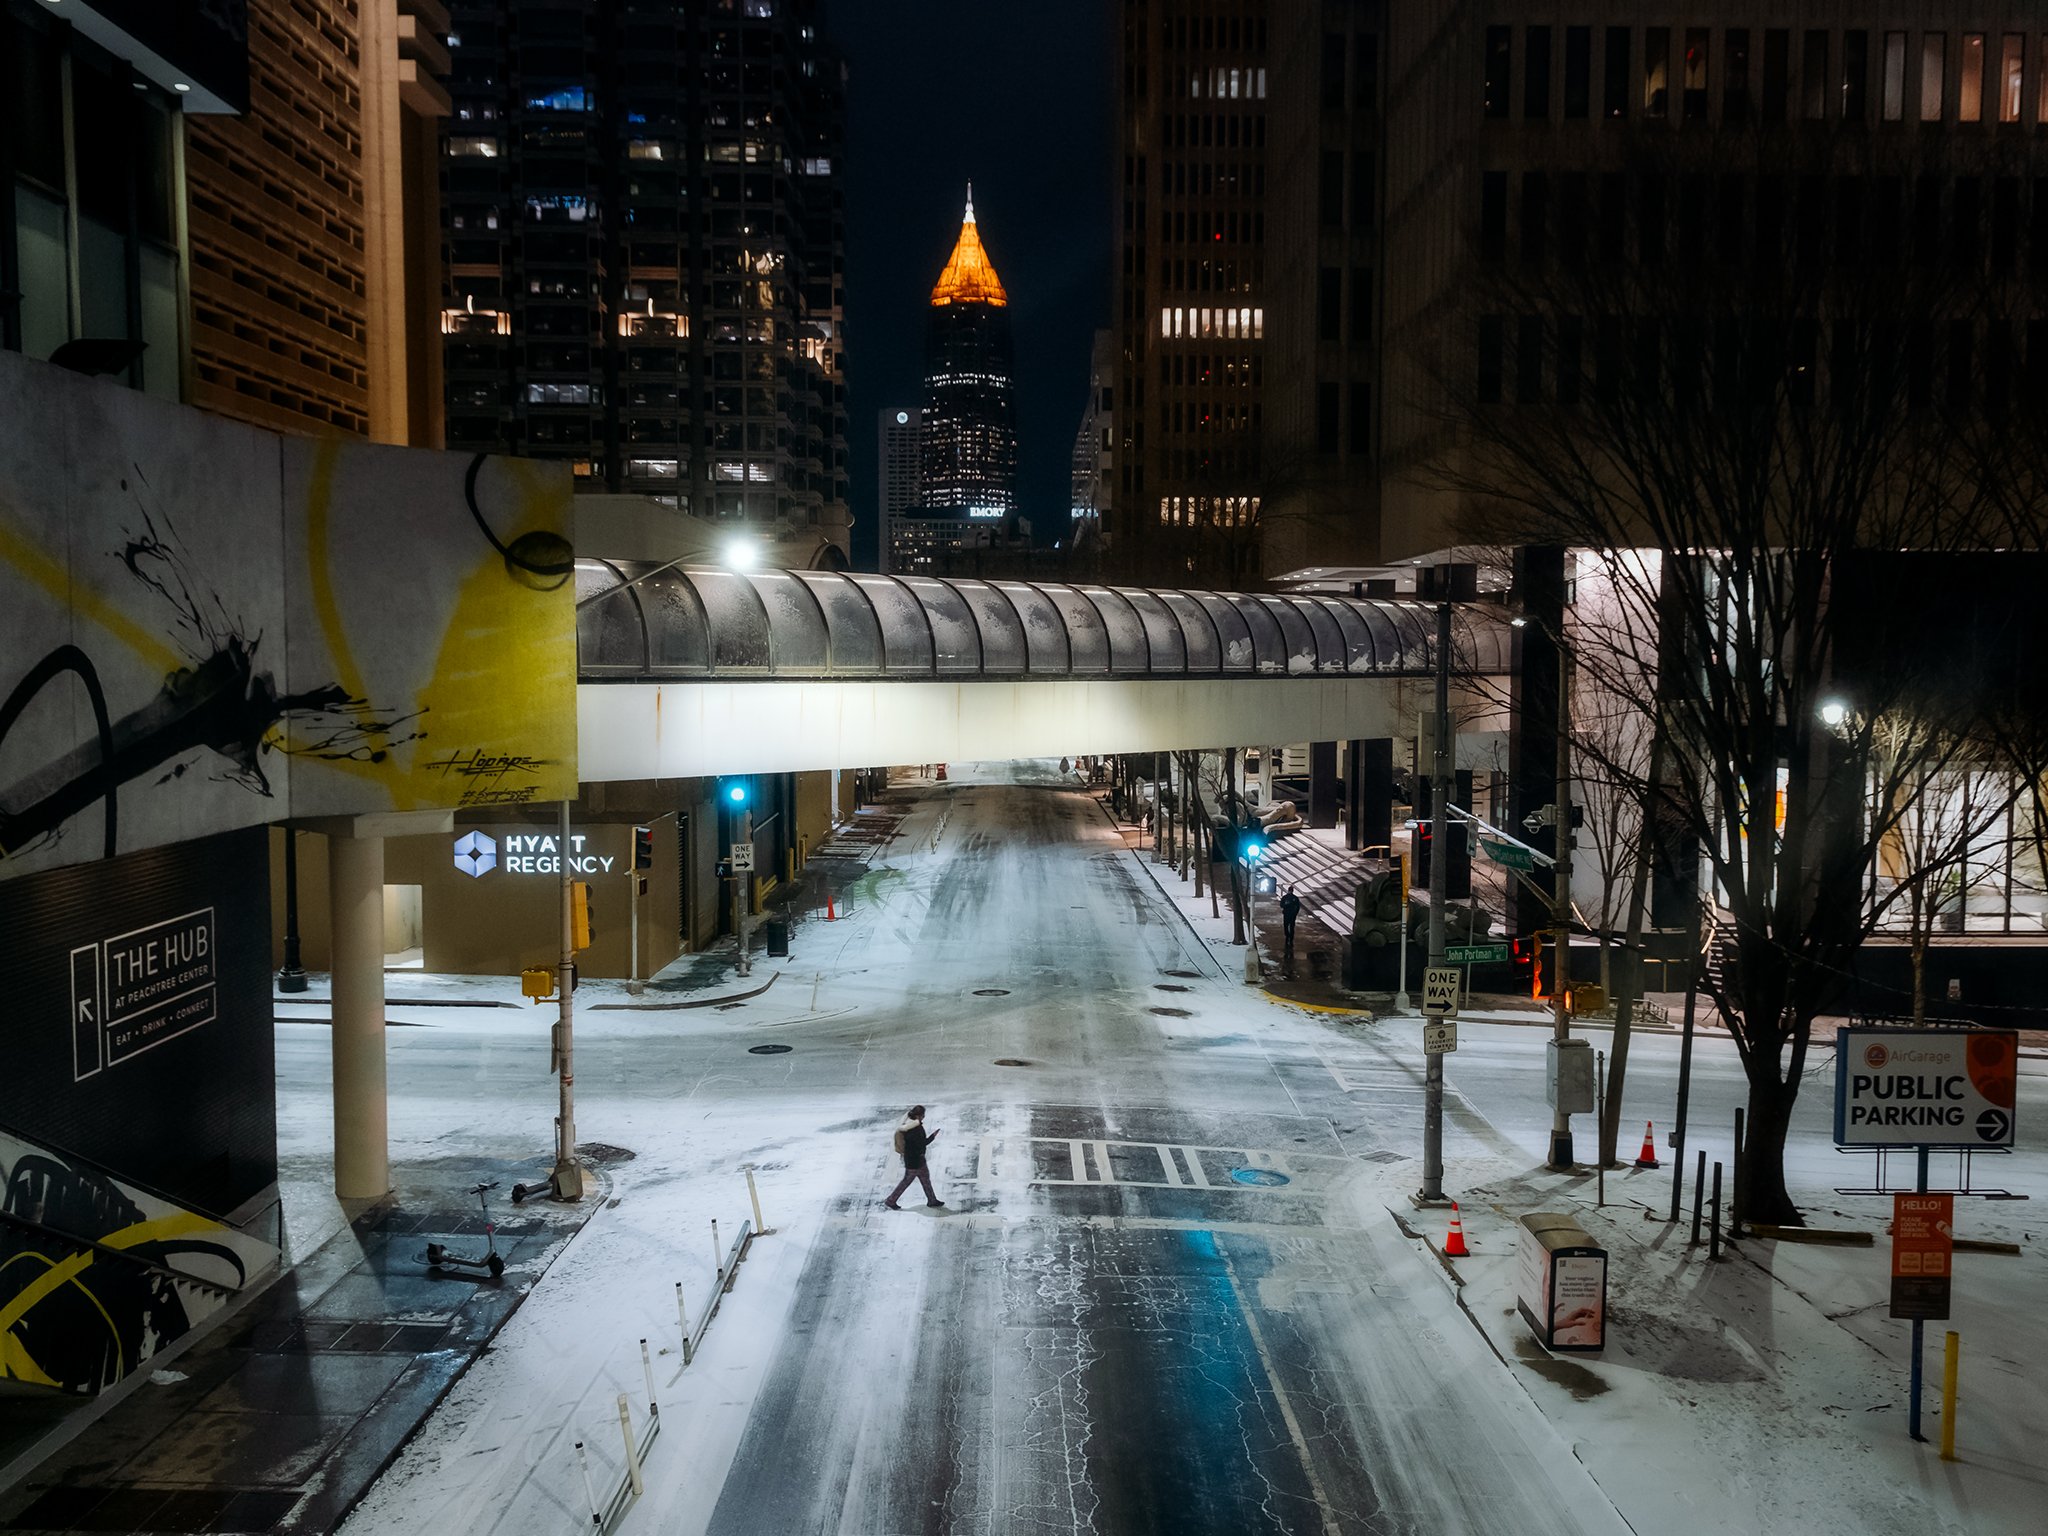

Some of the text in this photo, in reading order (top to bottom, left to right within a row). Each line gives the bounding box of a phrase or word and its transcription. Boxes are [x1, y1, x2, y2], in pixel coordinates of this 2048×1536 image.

[969, 507, 1006, 517] EMORY
[506, 835, 586, 853] HYAT
[113, 925, 208, 987] THE HUB
[1447, 949, 1492, 961] John Portman
[1428, 972, 1457, 984] ONE
[115, 965, 209, 1009] AT PEACHTREE CENTER
[1427, 985, 1456, 998] WAY
[116, 998, 209, 1046] EAT DRINK CONNECT
[1890, 1050, 1951, 1064] AirGarage
[1853, 1075, 1965, 1100] PUBLIC
[1851, 1106, 1965, 1126] PARKING
[1901, 1200, 1942, 1210] HELLO!
